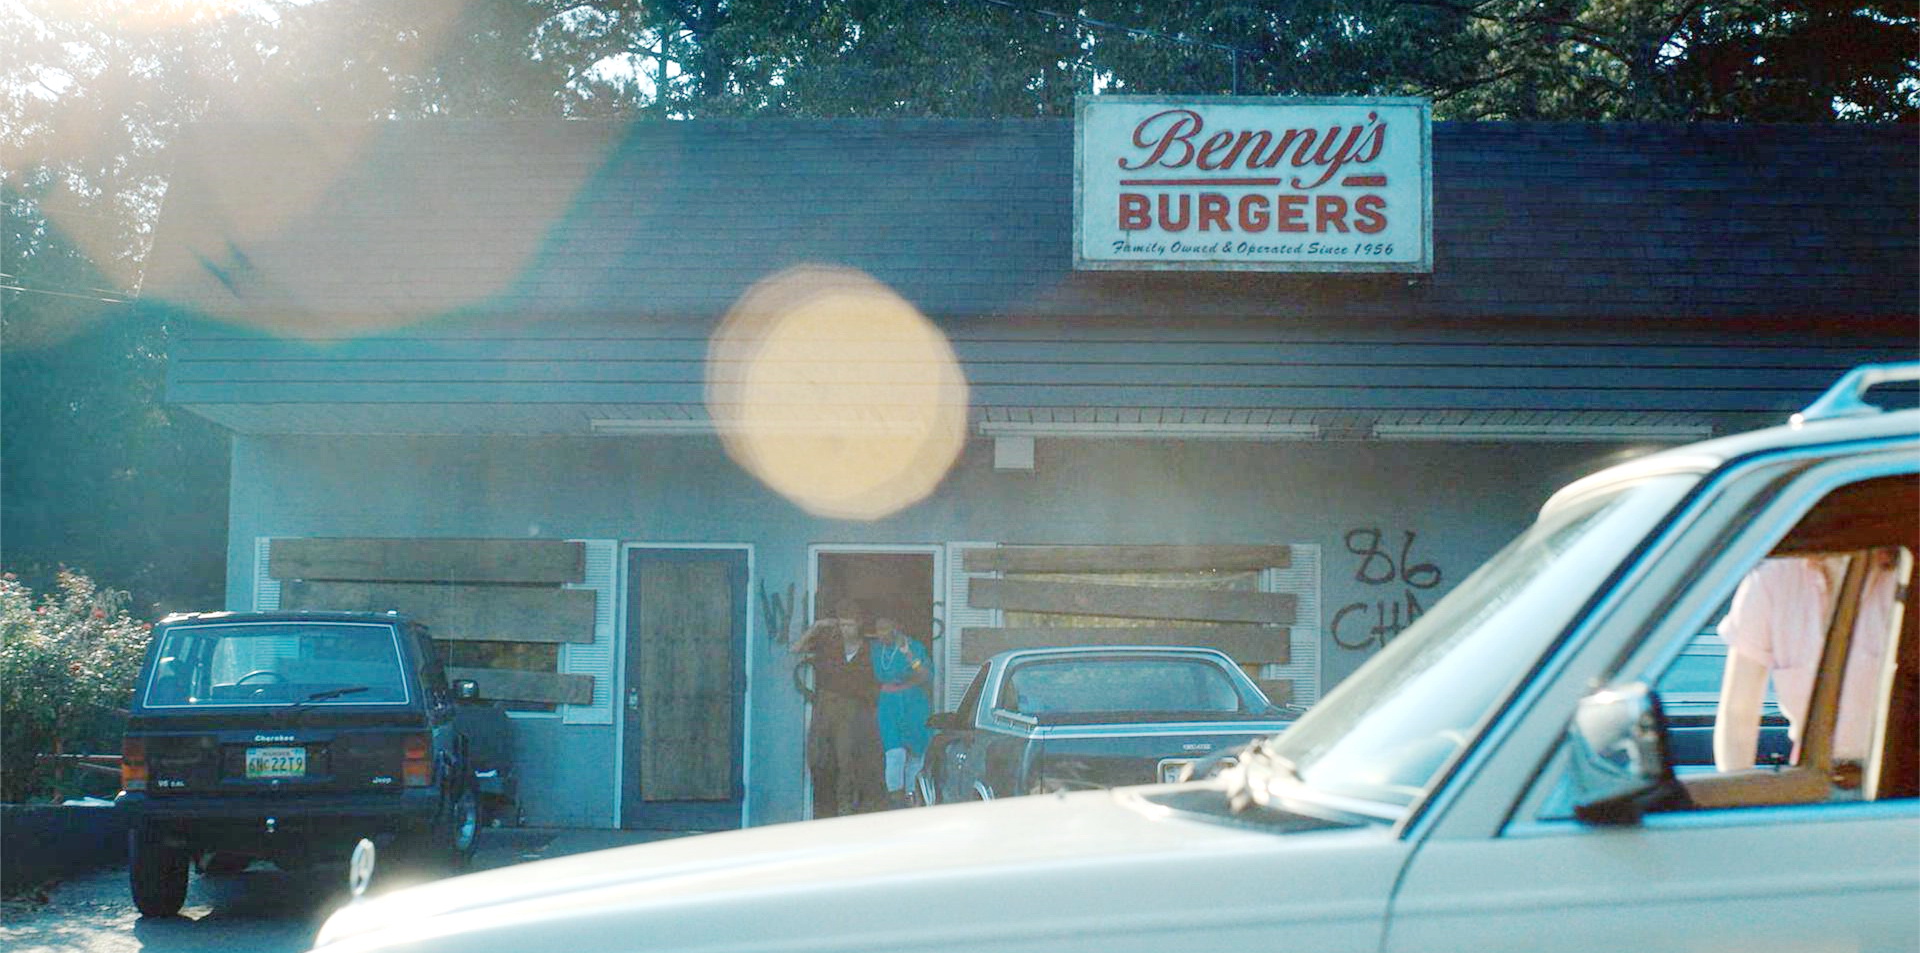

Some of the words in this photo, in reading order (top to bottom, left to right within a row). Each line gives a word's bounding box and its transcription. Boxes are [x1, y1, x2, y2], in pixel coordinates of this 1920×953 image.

[1118, 109, 1387, 190] Benny's
[1118, 193, 1387, 233] BURGERS
[1112, 240, 1165, 255] Family
[1170, 241, 1218, 253] Owned
[1222, 241, 1232, 253] &
[1237, 241, 1303, 255] Operated
[1307, 242, 1348, 254] Since
[1354, 243, 1394, 255] 1956
[1344, 528, 1442, 589] 86
